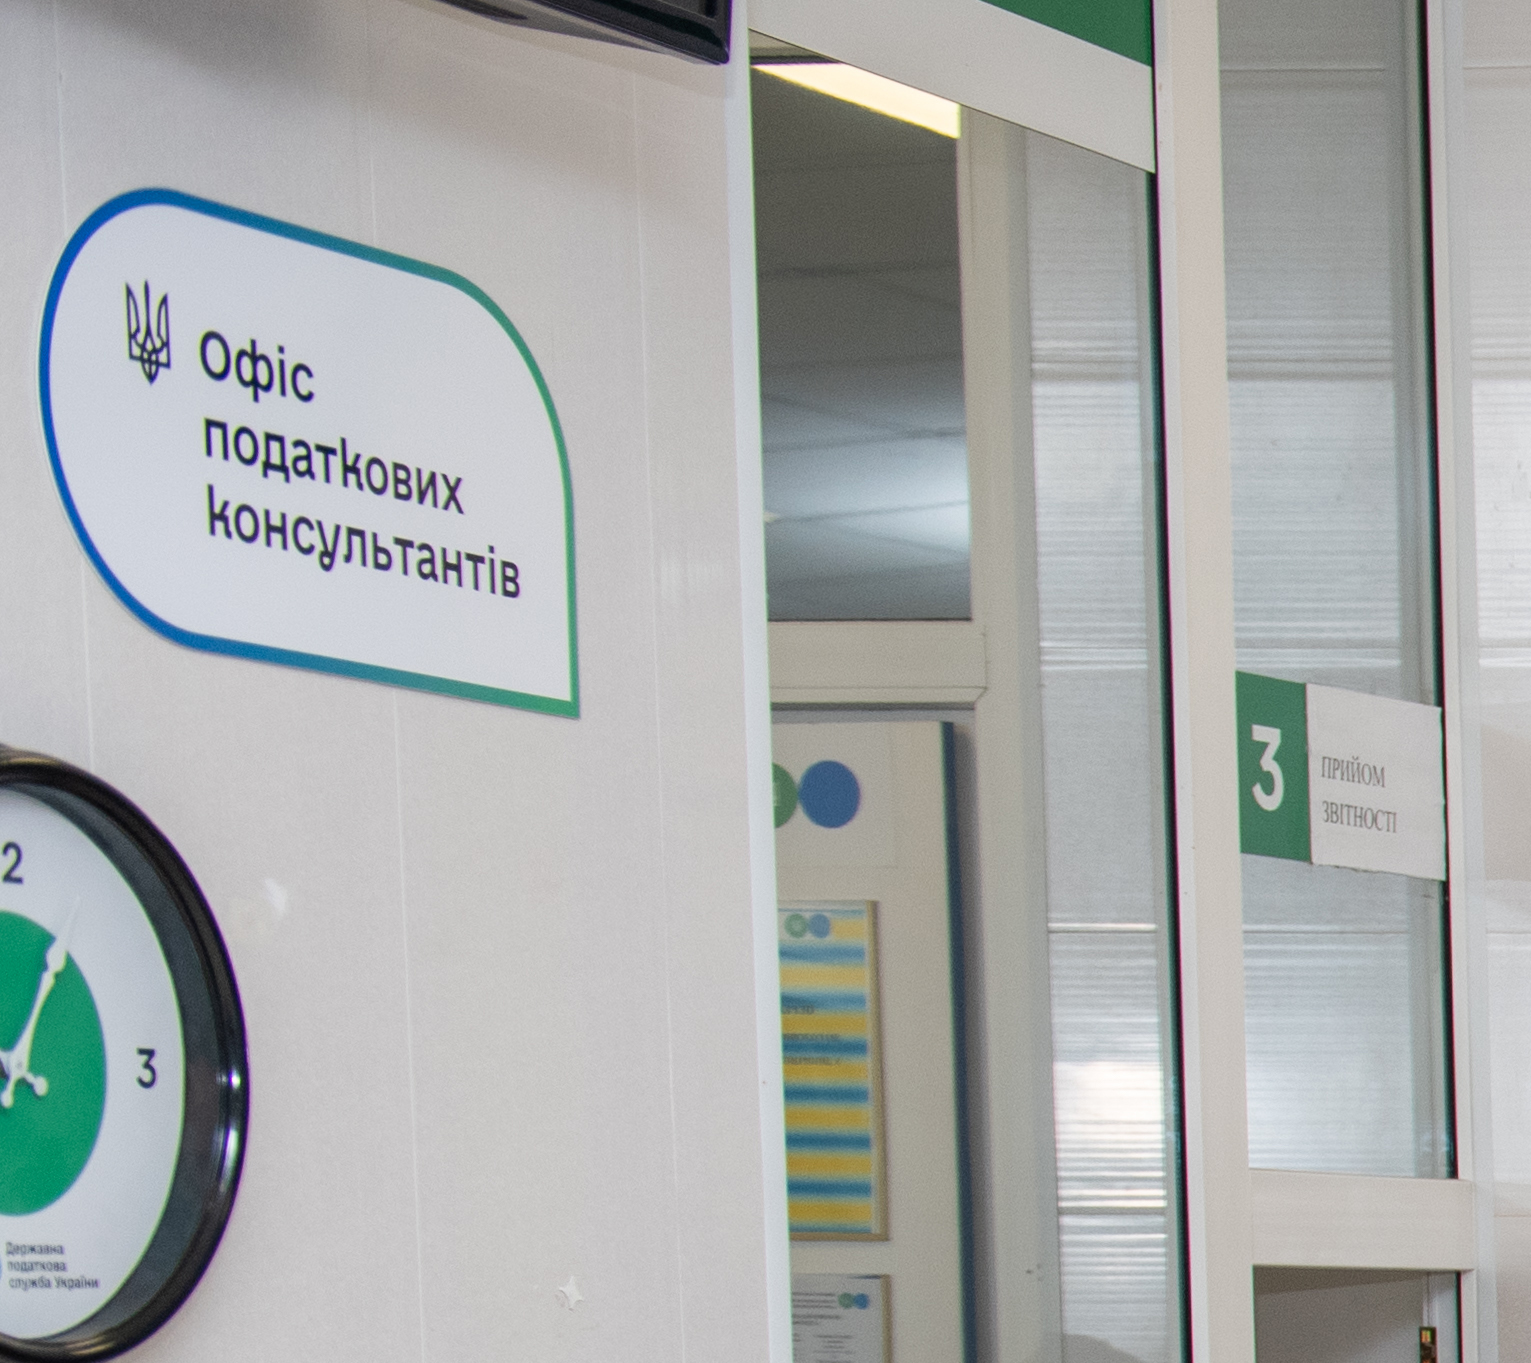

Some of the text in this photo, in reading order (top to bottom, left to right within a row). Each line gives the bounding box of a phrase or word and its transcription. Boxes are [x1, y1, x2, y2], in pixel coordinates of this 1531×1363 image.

[199, 330, 315, 403] Офіс
[204, 419, 464, 513] податкових
[207, 485, 521, 598] консультантів
[1249, 723, 1286, 813] 3
[1320, 755, 1386, 788] ПРИЙОМ
[1321, 800, 1397, 833] ЗВІТНОСТІ
[136, 1047, 157, 1089] 3
[5, 1241, 65, 1256] Державна
[7, 1260, 67, 1273] податкова
